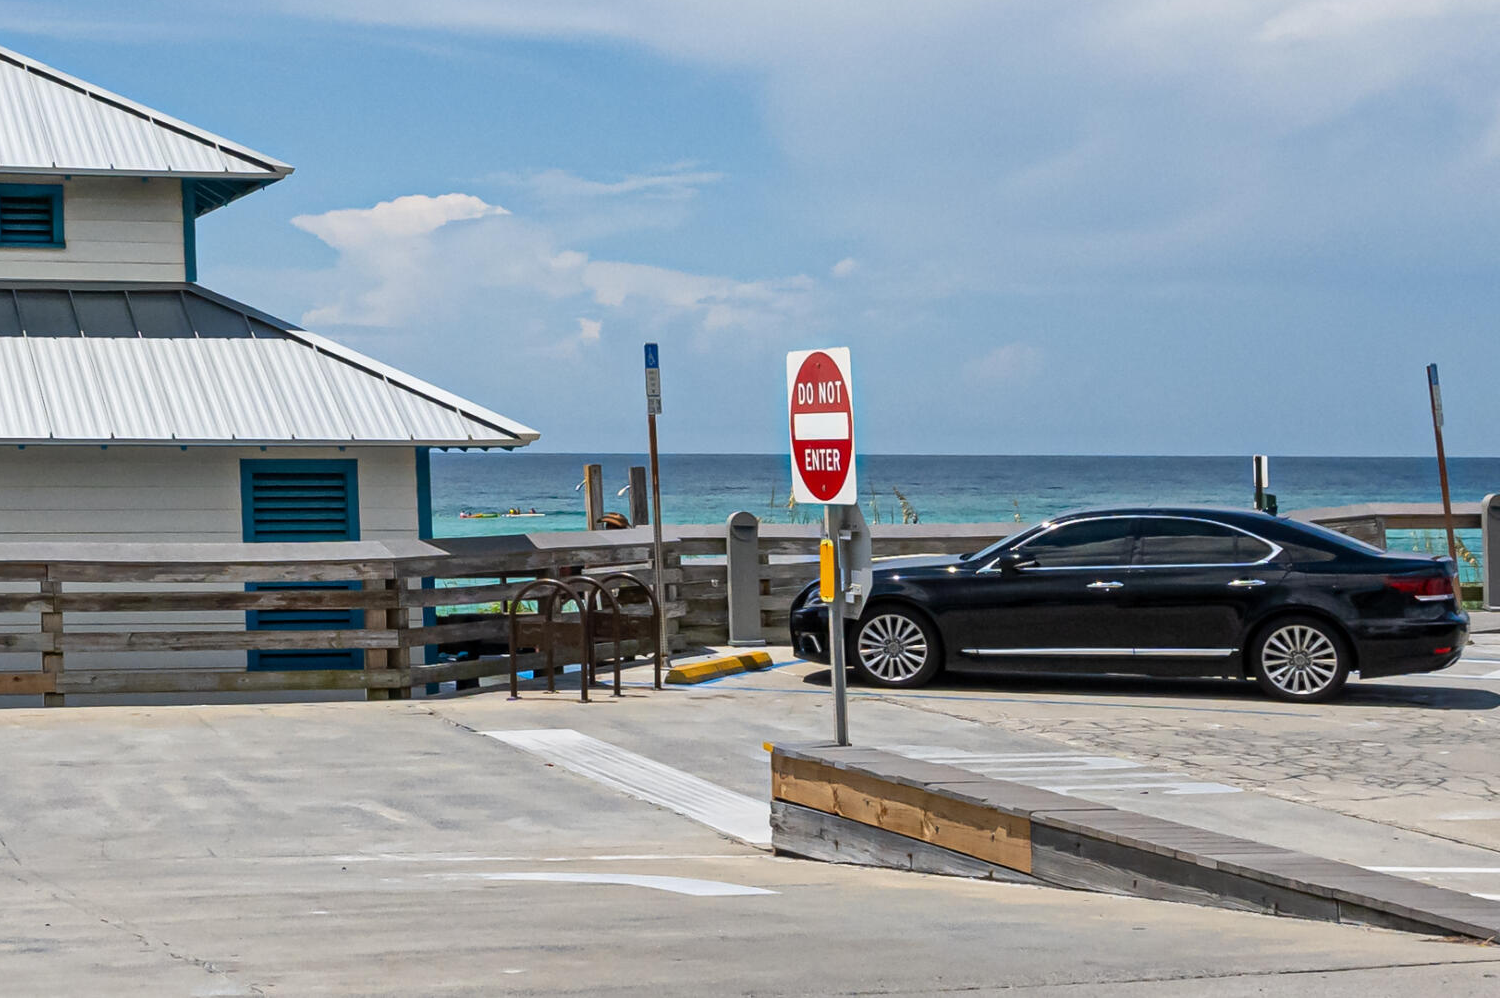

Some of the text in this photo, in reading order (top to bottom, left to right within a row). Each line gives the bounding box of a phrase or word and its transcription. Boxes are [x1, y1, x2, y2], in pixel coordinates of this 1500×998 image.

[798, 381, 842, 405] DO NOT
[804, 448, 841, 472] ENTER
